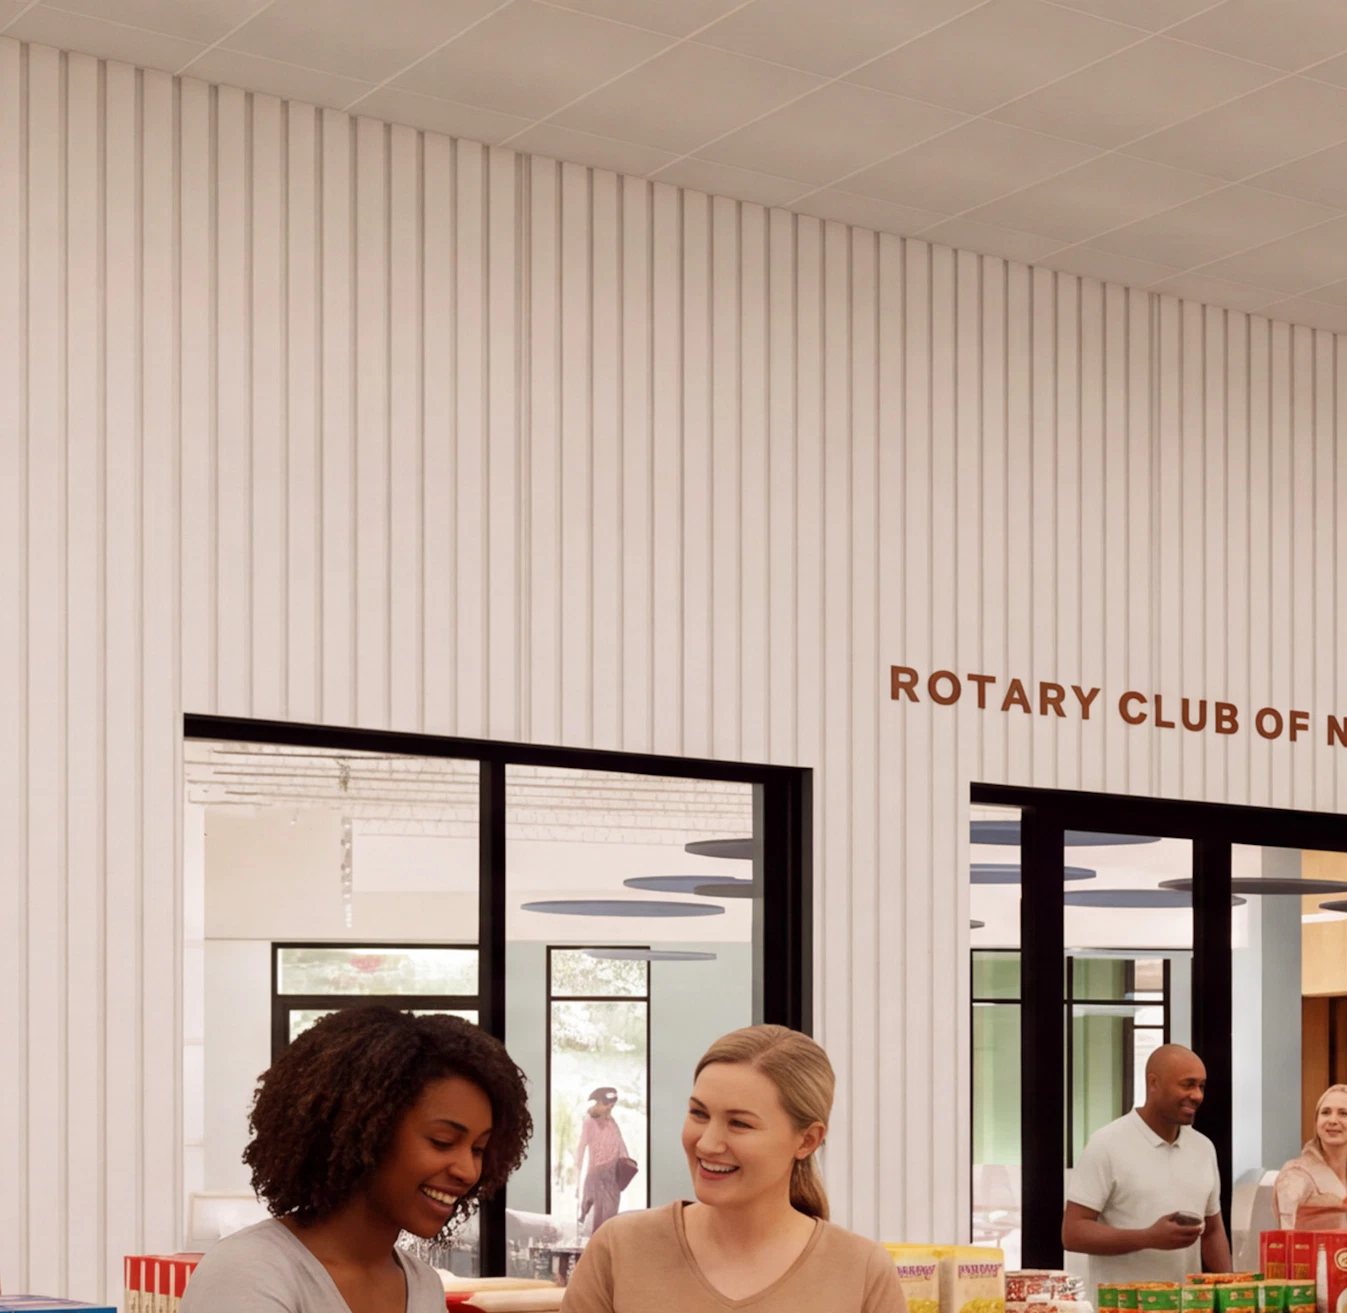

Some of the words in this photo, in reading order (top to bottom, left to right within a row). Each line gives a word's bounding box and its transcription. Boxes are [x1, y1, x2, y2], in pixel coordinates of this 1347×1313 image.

[890, 664, 1101, 721] ROTARY
[1118, 690, 1240, 736] CLUB
[1255, 706, 1310, 743] OF
